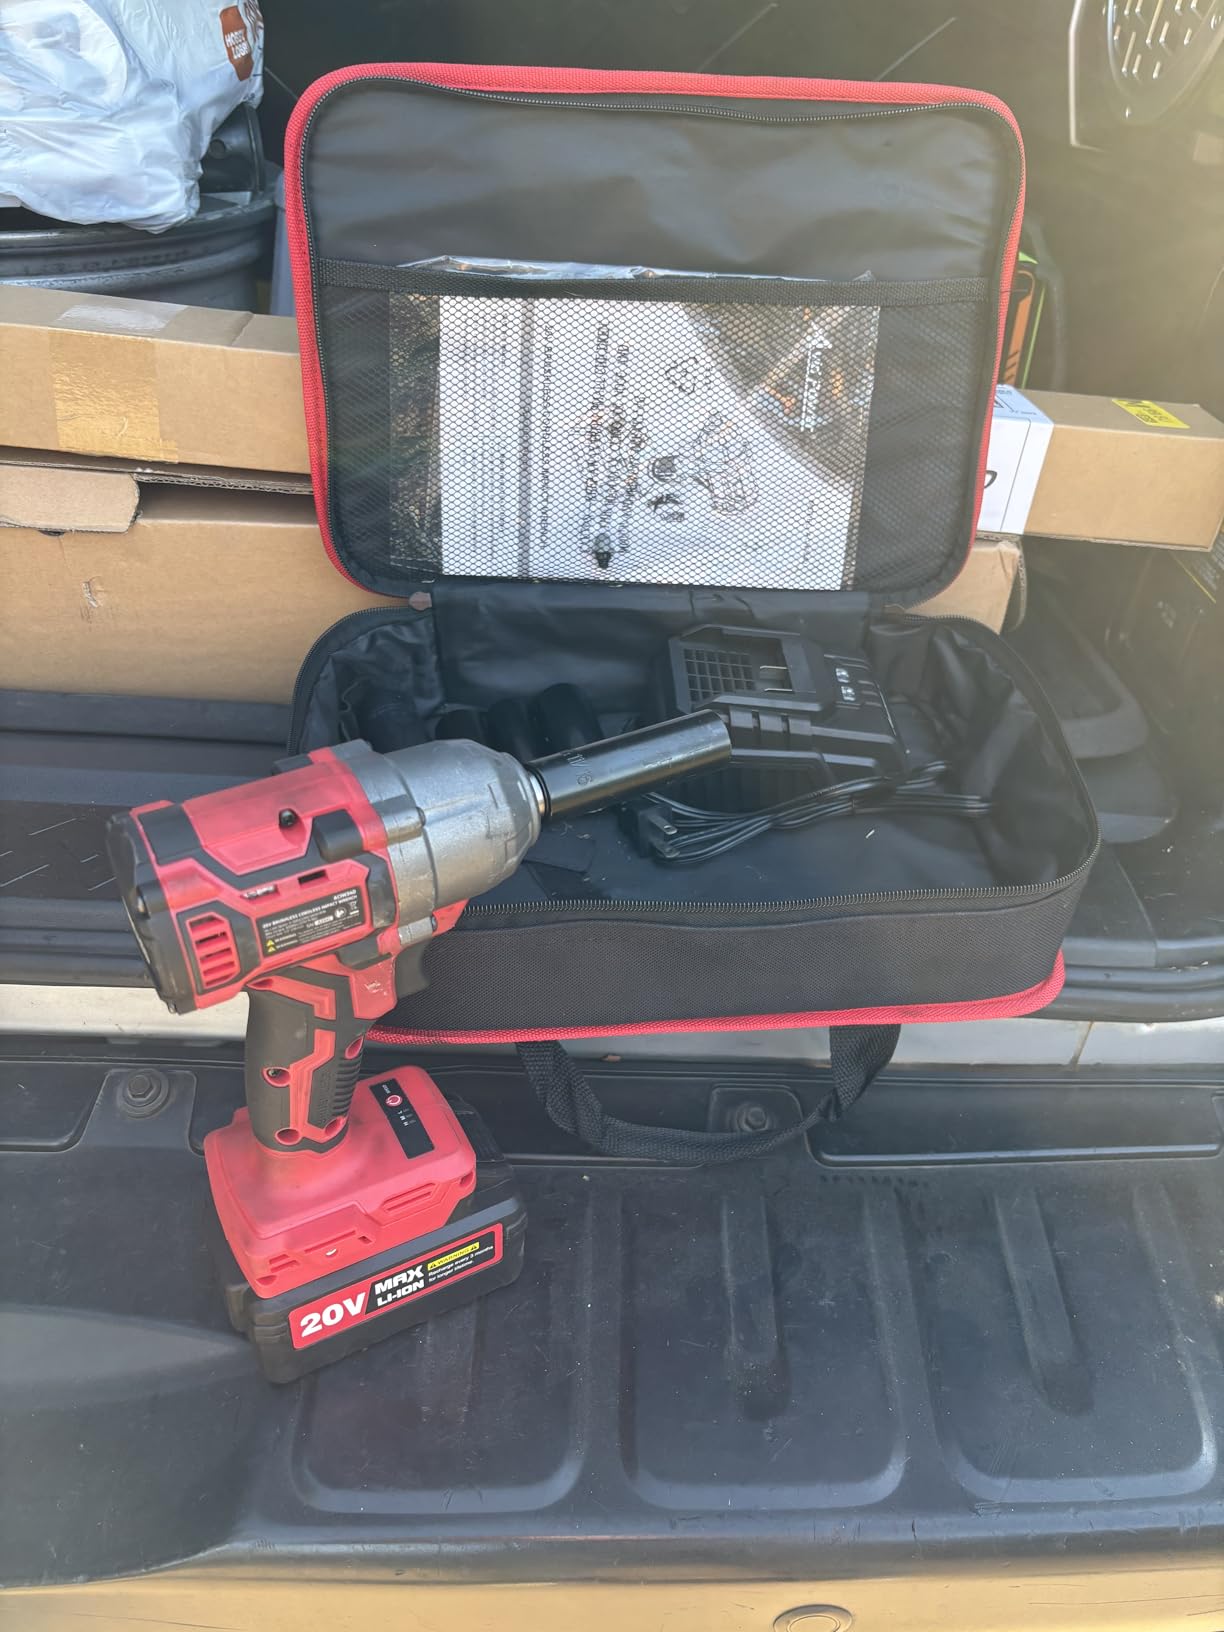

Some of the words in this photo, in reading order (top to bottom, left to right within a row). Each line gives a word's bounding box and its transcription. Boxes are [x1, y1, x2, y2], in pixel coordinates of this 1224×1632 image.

[428, 1263, 454, 1277] Recharge
[454, 1256, 469, 1265] every
[474, 1246, 494, 1256] months
[437, 1248, 470, 1265] WARNING
[374, 1265, 424, 1295] MAX
[437, 1269, 453, 1279] longer
[377, 1279, 425, 1307] LI-ION
[300, 1292, 365, 1338] 20V
